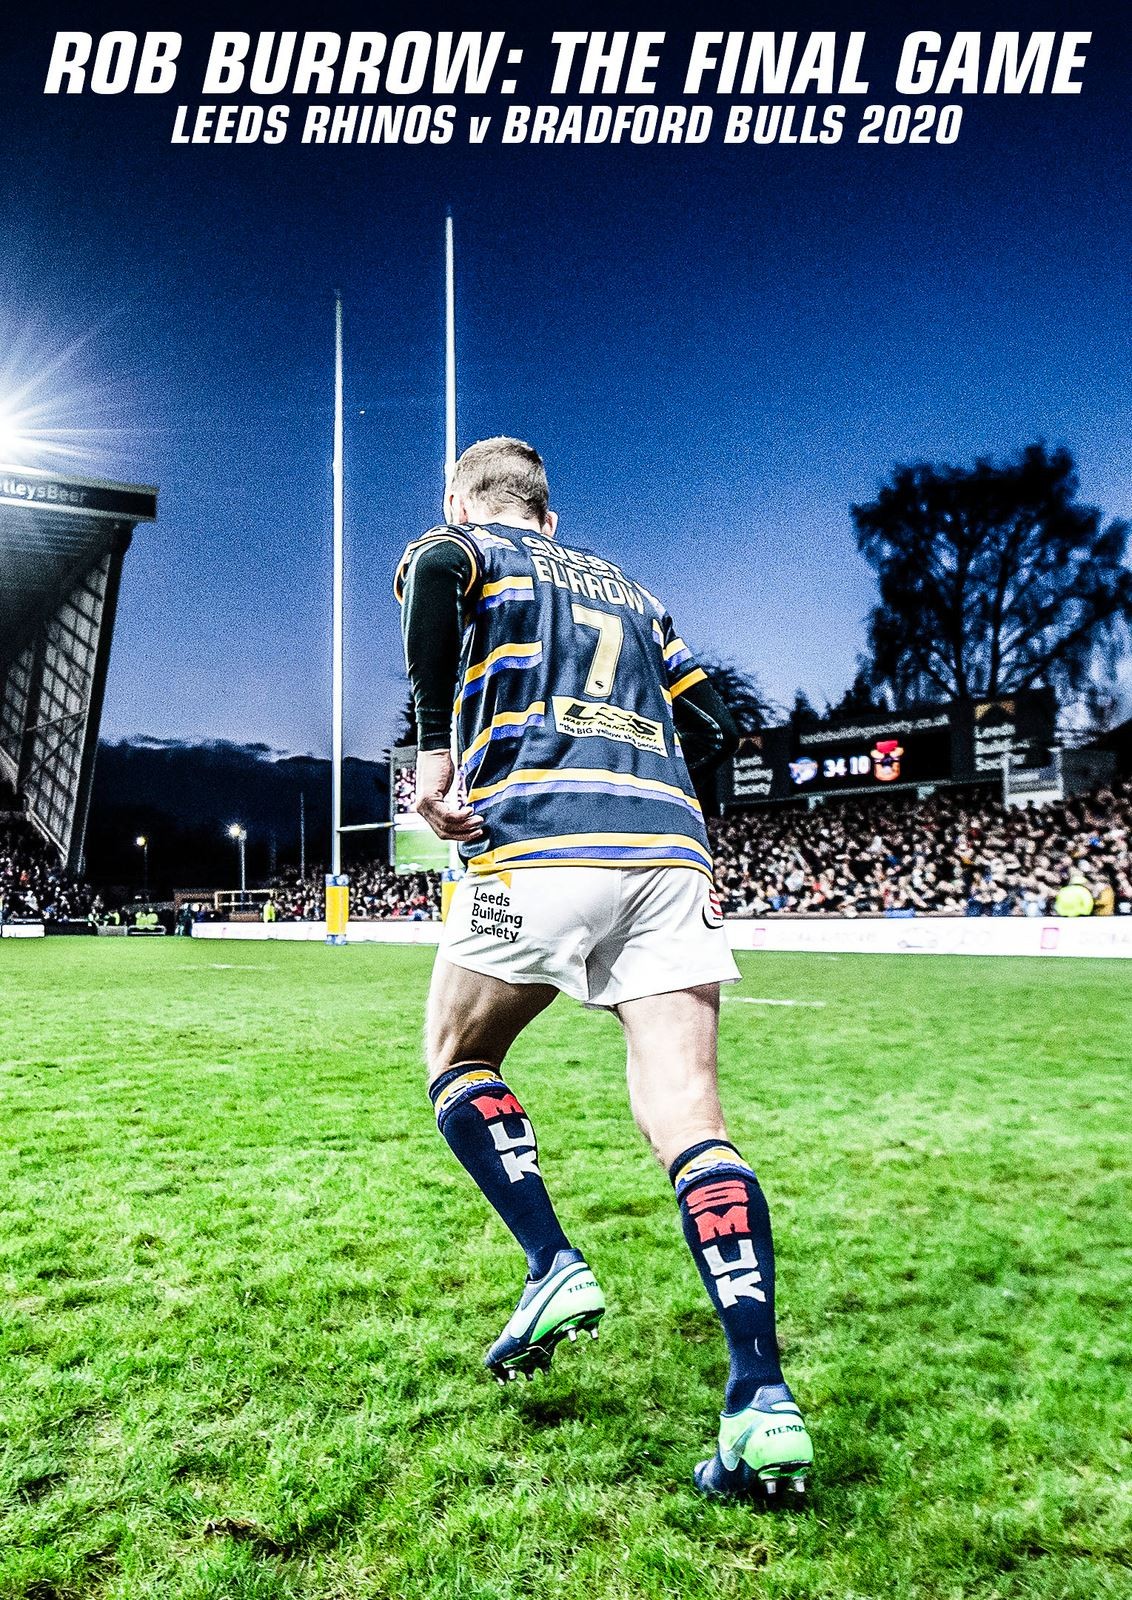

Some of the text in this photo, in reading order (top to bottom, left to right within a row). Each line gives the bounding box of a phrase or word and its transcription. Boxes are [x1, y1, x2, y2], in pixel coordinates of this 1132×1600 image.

[571, 604, 625, 698] 7
[576, 727, 593, 735] BIG
[823, 755, 871, 778] 34 10
[474, 886, 510, 907] Leeds
[472, 903, 523, 929] Building
[470, 919, 519, 943] Society
[471, 1093, 541, 1184] MUK
